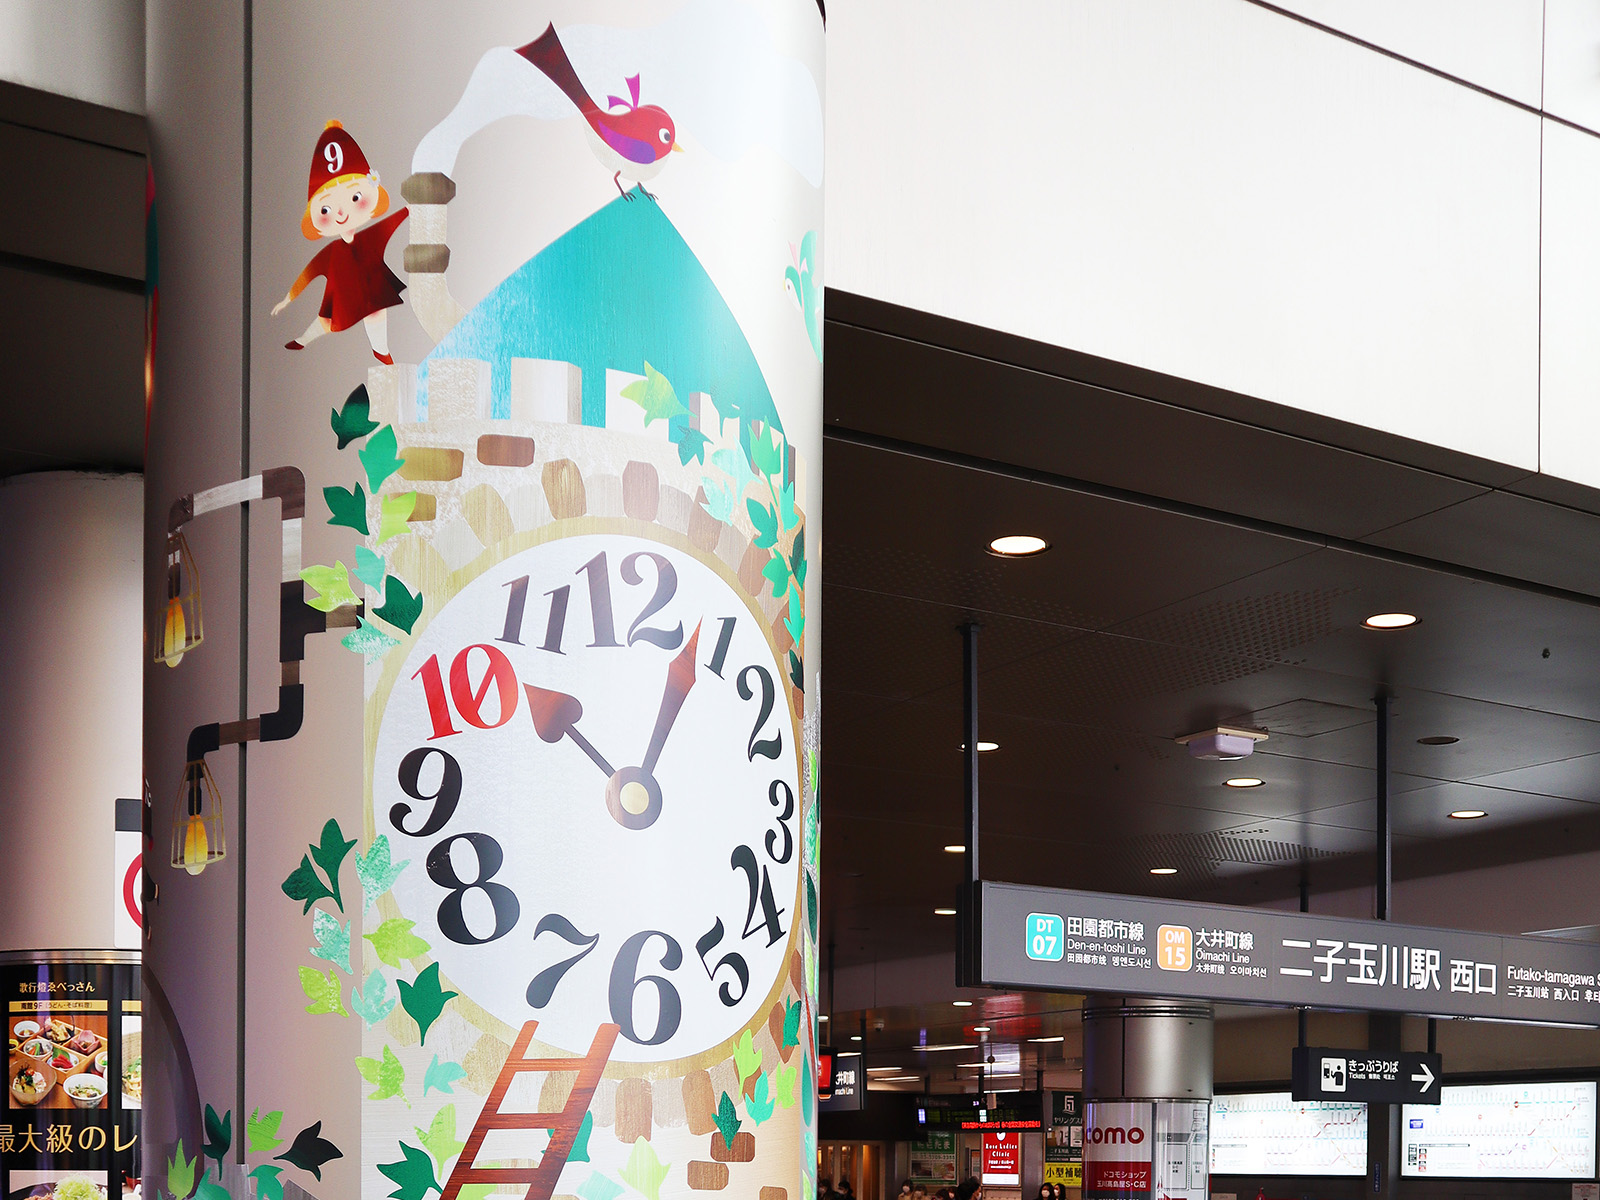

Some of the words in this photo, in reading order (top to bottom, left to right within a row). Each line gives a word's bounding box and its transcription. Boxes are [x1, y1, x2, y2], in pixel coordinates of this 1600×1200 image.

[324, 141, 344, 174] 9
[494, 575, 570, 655] 11
[575, 551, 684, 650] 12
[703, 616, 737, 680] 1
[411, 643, 519, 741] 10
[736, 664, 782, 762] 2
[389, 747, 463, 837] 9
[765, 779, 794, 864] 3
[426, 832, 520, 945] 8
[730, 844, 787, 949] 4
[1032, 934, 1057, 956] 07
[1036, 918, 1054, 933] DT
[1067, 916, 1144, 941] 田園都市線
[1067, 938, 1125, 953] Den-en-toshi
[1127, 943, 1147, 955] Line
[1165, 930, 1185, 944] OM
[1195, 927, 1254, 951] 大井町線
[526, 913, 600, 1009] 7
[695, 917, 749, 1007] 5
[1164, 946, 1186, 966] 15
[1232, 952, 1250, 963] Line
[1279, 938, 1441, 991] 二子玉川駅
[1450, 959, 1497, 995] 西口
[1507, 965, 1595, 988] Futako-tamagawa
[608, 930, 682, 1045] 6
[1348, 1060, 1399, 1073] きっぷうりば
[0, 1123, 138, 1153] 最大級のレ
[1103, 1171, 1147, 1179] ドコモショップ
